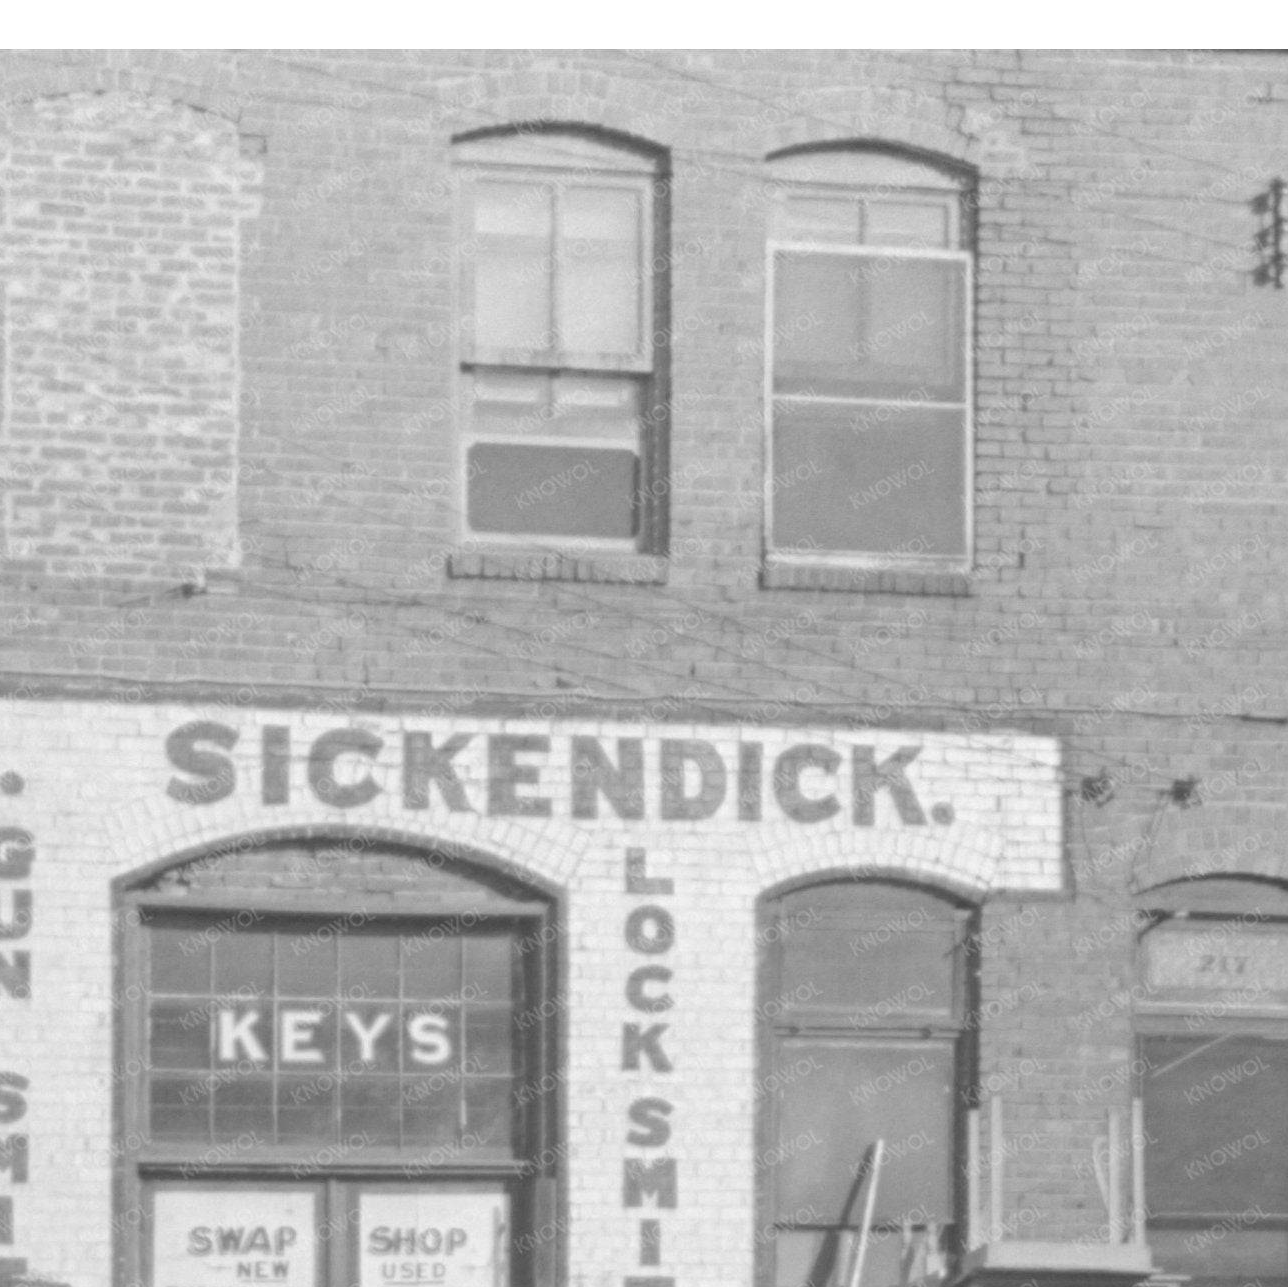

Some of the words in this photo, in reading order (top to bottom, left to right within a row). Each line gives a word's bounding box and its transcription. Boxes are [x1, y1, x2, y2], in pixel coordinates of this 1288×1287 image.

[164, 720, 955, 826] SICKENDICK.
[216, 1010, 453, 1065] KEYS
[186, 1226, 297, 1257] SWAP
[368, 1226, 468, 1257] SHOP
[237, 1261, 290, 1279] NEW
[381, 1262, 447, 1280] USED
